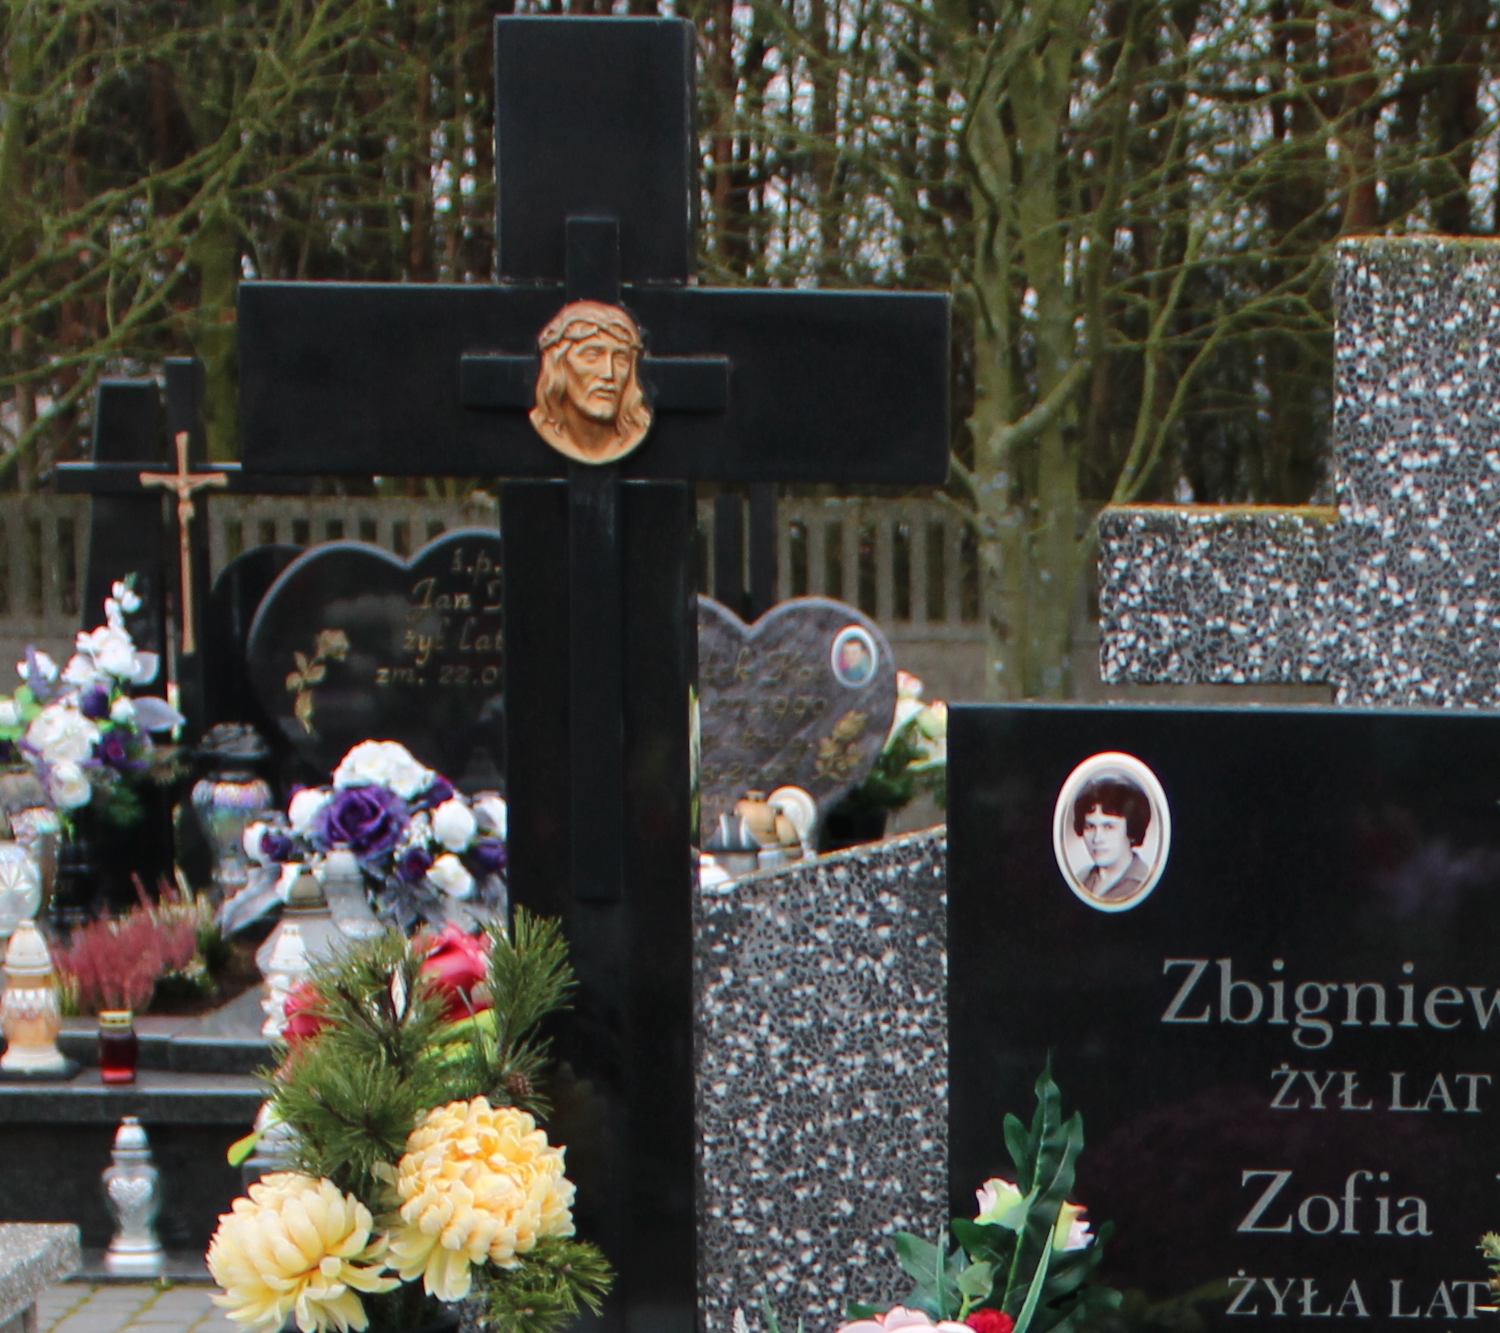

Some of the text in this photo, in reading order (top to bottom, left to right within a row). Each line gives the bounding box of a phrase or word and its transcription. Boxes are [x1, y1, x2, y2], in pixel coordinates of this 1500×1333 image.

[1269, 1062, 1373, 1110] ŻYŁ
[1387, 1071, 1492, 1112] LAT
[1236, 1168, 1433, 1236] Zofia
[1225, 1268, 1371, 1318] ŻYŁA
[1388, 1278, 1492, 1320] LAT
